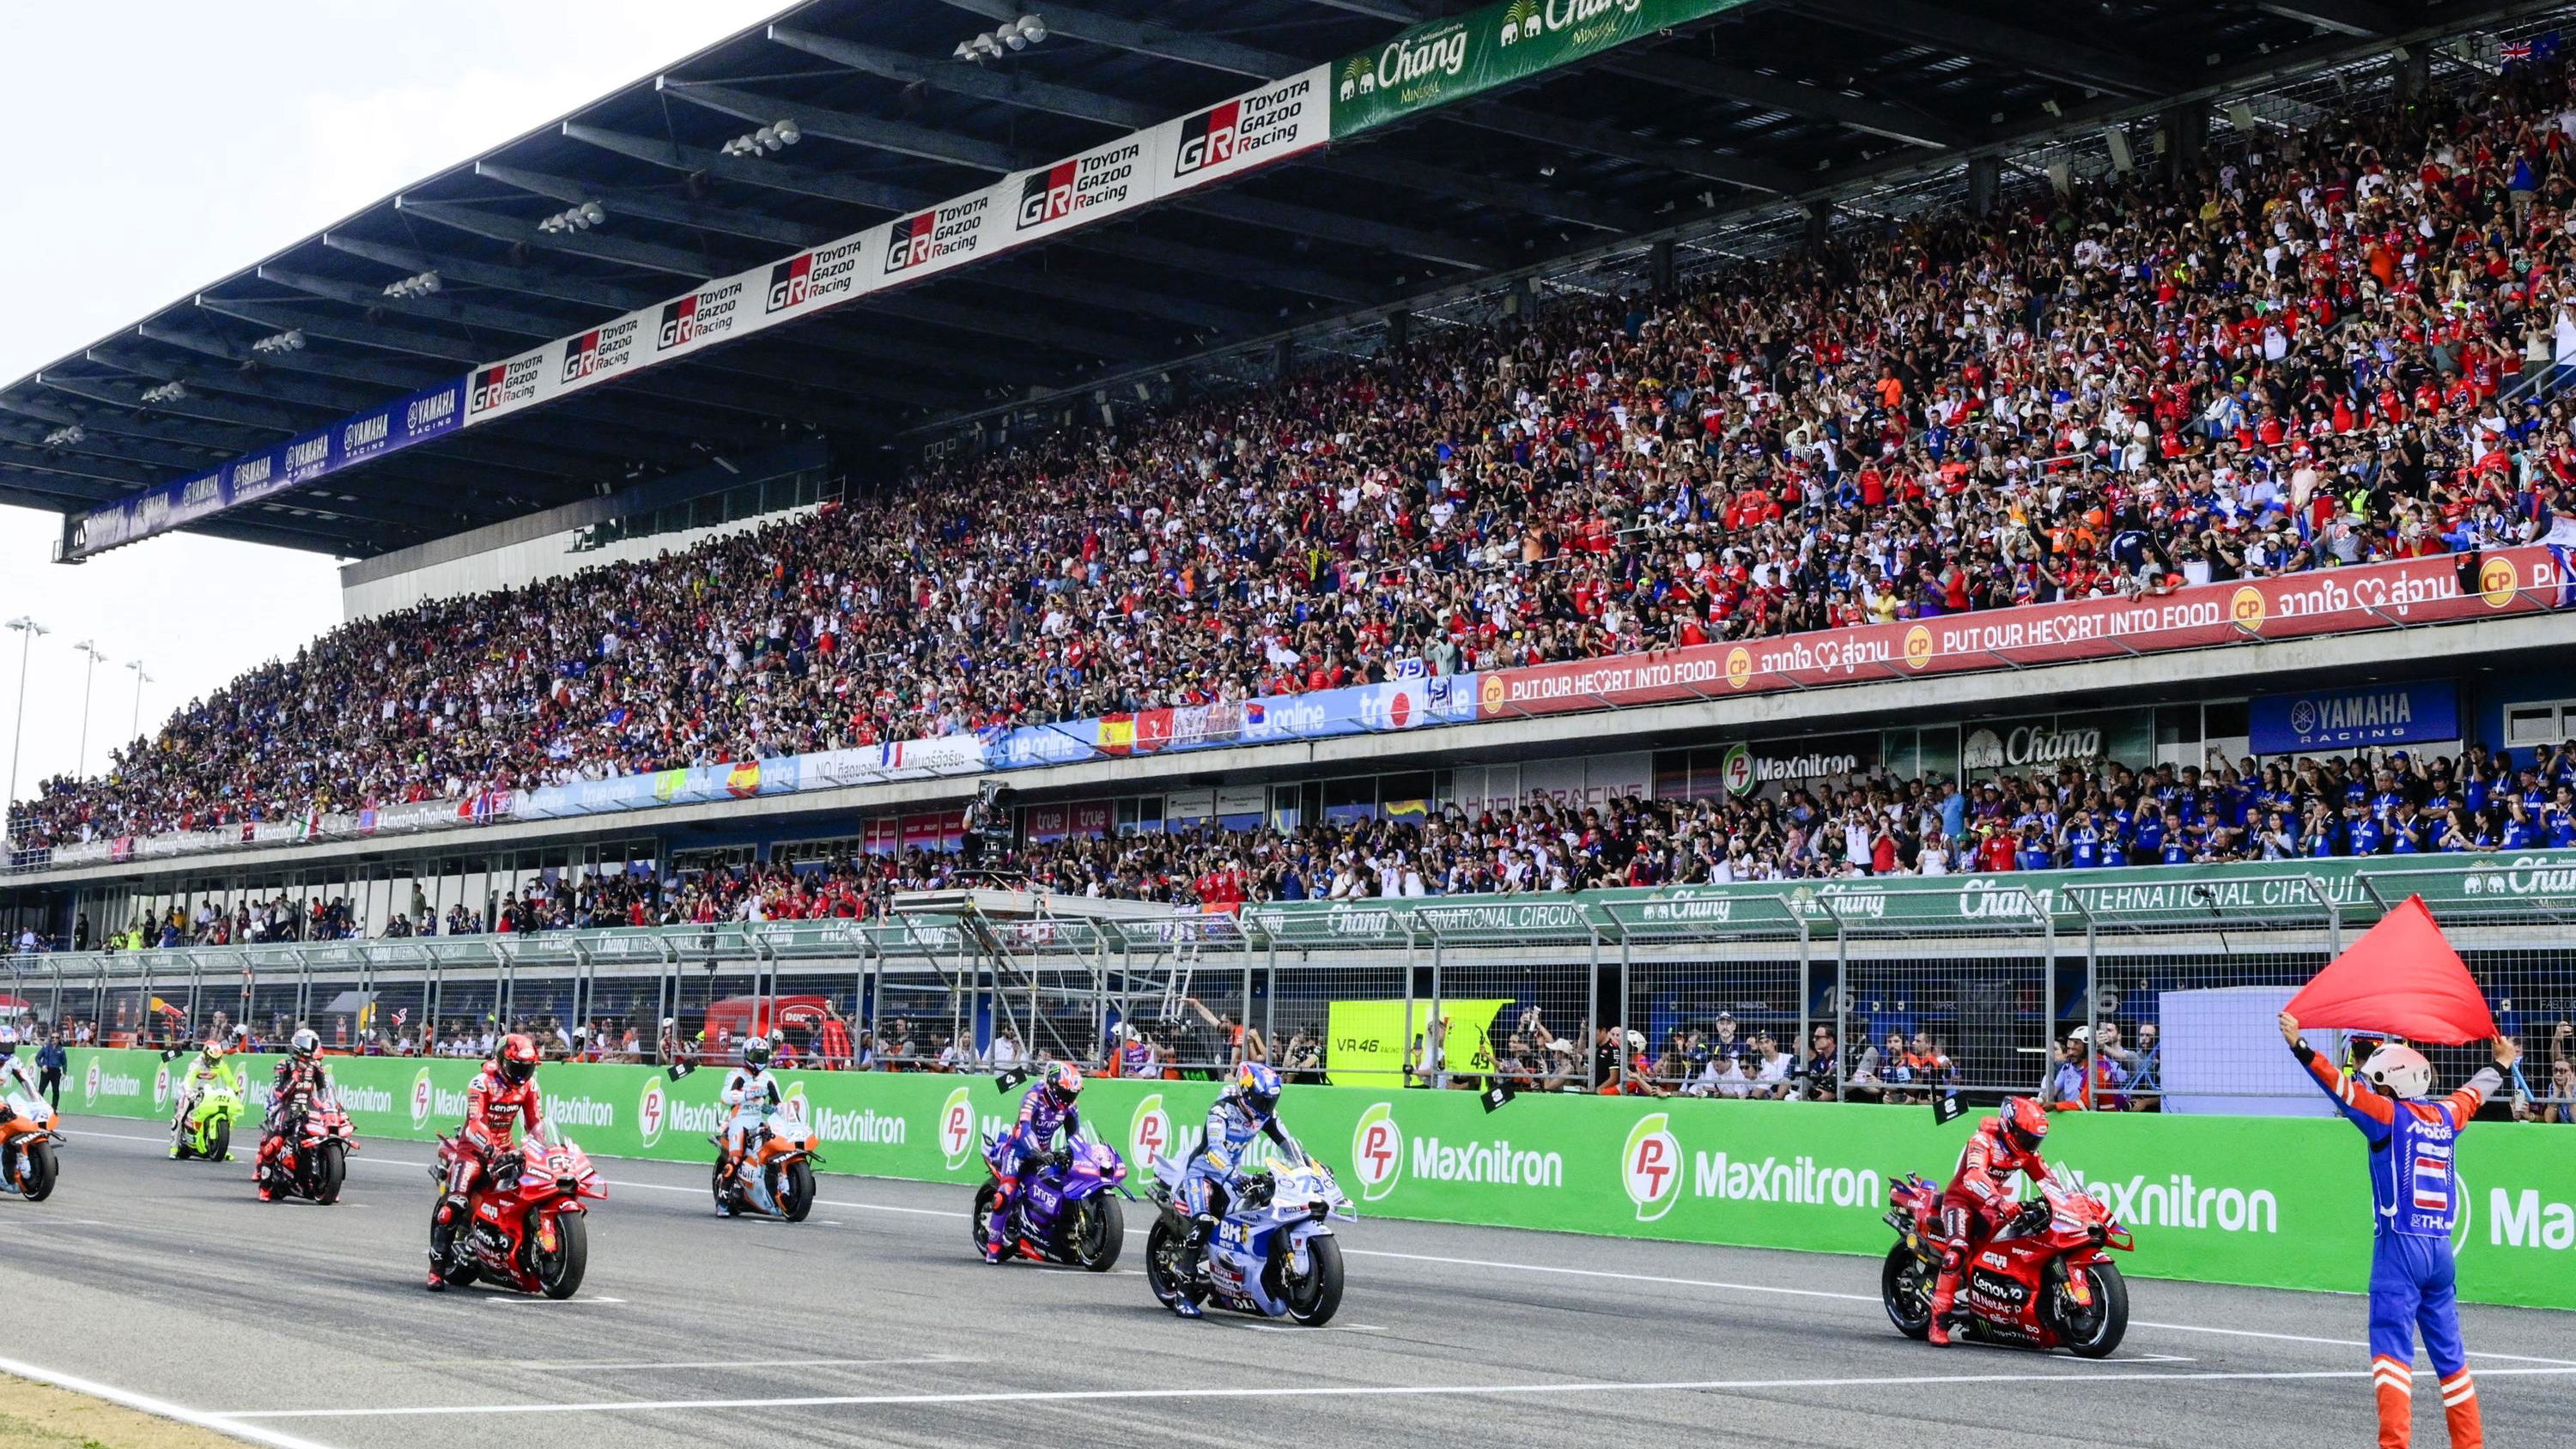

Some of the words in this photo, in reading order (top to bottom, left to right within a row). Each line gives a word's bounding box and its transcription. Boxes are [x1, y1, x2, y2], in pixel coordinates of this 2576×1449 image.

[1546, 0, 1641, 32] Cha
[1378, 31, 1468, 88] Chang
[1244, 79, 1310, 114] TOYOTA
[1241, 100, 1302, 134] GAZOO
[1237, 122, 1297, 155] Racing
[1080, 143, 1139, 173] TOYOTA
[1076, 164, 1132, 191] GAZOO
[938, 197, 988, 222] TOYOTA
[1073, 184, 1127, 210] Racing
[934, 215, 981, 240] GAZOO
[815, 240, 861, 265] TOYOTA
[932, 233, 976, 258] Racing
[811, 258, 855, 282] GAZOO
[699, 282, 743, 306] TOYOTA
[809, 276, 851, 300] Racing
[696, 300, 737, 322] GAZOO
[601, 319, 638, 341] TOYOTA
[694, 316, 732, 338] Racing
[598, 336, 632, 355] GAZOO
[508, 355, 543, 375] TOYOTA
[596, 350, 629, 370] Racing
[505, 370, 538, 387] GAZOO
[503, 385, 535, 403] Racing
[418, 389, 455, 426] YAMAHA
[355, 414, 388, 444] YAMAHA
[410, 417, 452, 437] RACING
[295, 435, 328, 466] YAMAHA
[347, 440, 385, 458] RACING
[242, 456, 270, 483] YAMAHA
[191, 474, 219, 504] YAMAHA
[2484, 572, 2511, 592] CP
[2235, 598, 2260, 621] CP
[1943, 627, 1979, 653] PUT
[1984, 623, 2023, 648] OUR
[2110, 608, 2160, 636] INTO
[2163, 601, 2220, 629] FOOD
[1908, 637, 1929, 656] CP
[1396, 659, 1421, 678] 79
[1512, 678, 1541, 700] PUT
[1542, 674, 1571, 696] OUR
[1636, 662, 1671, 688] INTO
[1674, 658, 1716, 682] FOOD
[1729, 659, 1747, 676] CP
[1485, 686, 1501, 702] CP
[1273, 700, 1325, 731] online
[2318, 693, 2411, 730] YAMAHA
[1032, 731, 1073, 760] online
[2300, 728, 2404, 743] RACING
[1730, 756, 1750, 787] PT
[1756, 754, 1857, 782] Maxnitron
[1552, 784, 1642, 807] RACING
[375, 805, 458, 829] #AmazingThailand
[1036, 809, 1062, 830] true
[1079, 806, 1106, 827] true
[1671, 889, 1731, 921] Chang
[1820, 884, 1886, 918] Chang
[1959, 878, 2053, 926] Chang
[2062, 882, 2255, 912] INTERNATIONAL
[2263, 876, 2372, 906] CIRCUIT
[1327, 903, 1388, 939] Chang
[1391, 906, 1515, 931] INTERNATIONAL
[1519, 903, 1589, 926] CIRCUIT
[598, 931, 630, 956] Chang
[100, 1073, 140, 1097] Maxnitron
[546, 1094, 613, 1126] Maxnitron
[645, 1094, 660, 1132] PT
[670, 1100, 732, 1133] Maxnit
[815, 1106, 906, 1144] Maxnitron
[949, 1107, 968, 1152] PT
[1139, 1116, 1163, 1165] PT
[1364, 1126, 1394, 1180] PT
[1413, 1136, 1563, 1187] Maxnitron
[1636, 1138, 1670, 1198] PT
[1695, 1149, 1880, 1209] Maxnitron
[2491, 1187, 2576, 1250] Ma
[1220, 1220, 1250, 1246] BK8
[1928, 1231, 1947, 1243] Lenov
[1982, 1251, 2008, 1270] GIVI
[1973, 1272, 2023, 1300] Lenovo
